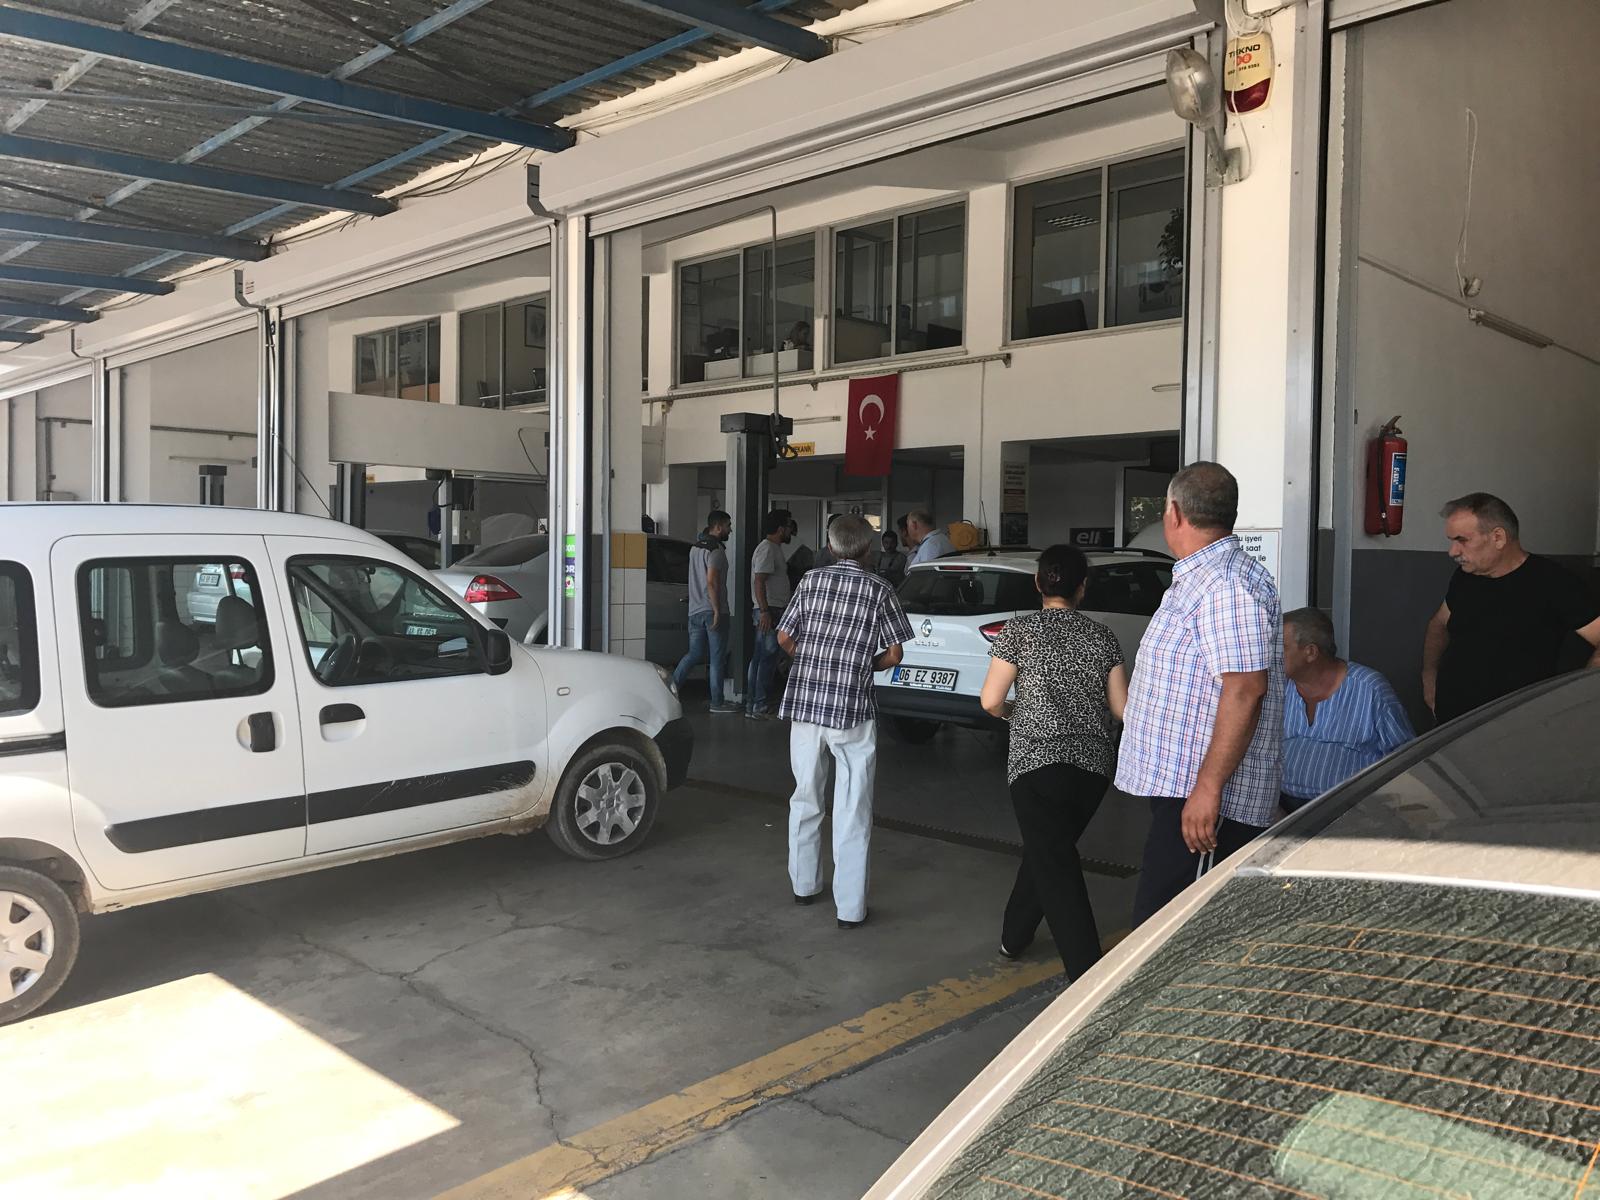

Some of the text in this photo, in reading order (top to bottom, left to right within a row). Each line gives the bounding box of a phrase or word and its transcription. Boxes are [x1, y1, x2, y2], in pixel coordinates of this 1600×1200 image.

[899, 668, 955, 685] 06 EZ 9387
